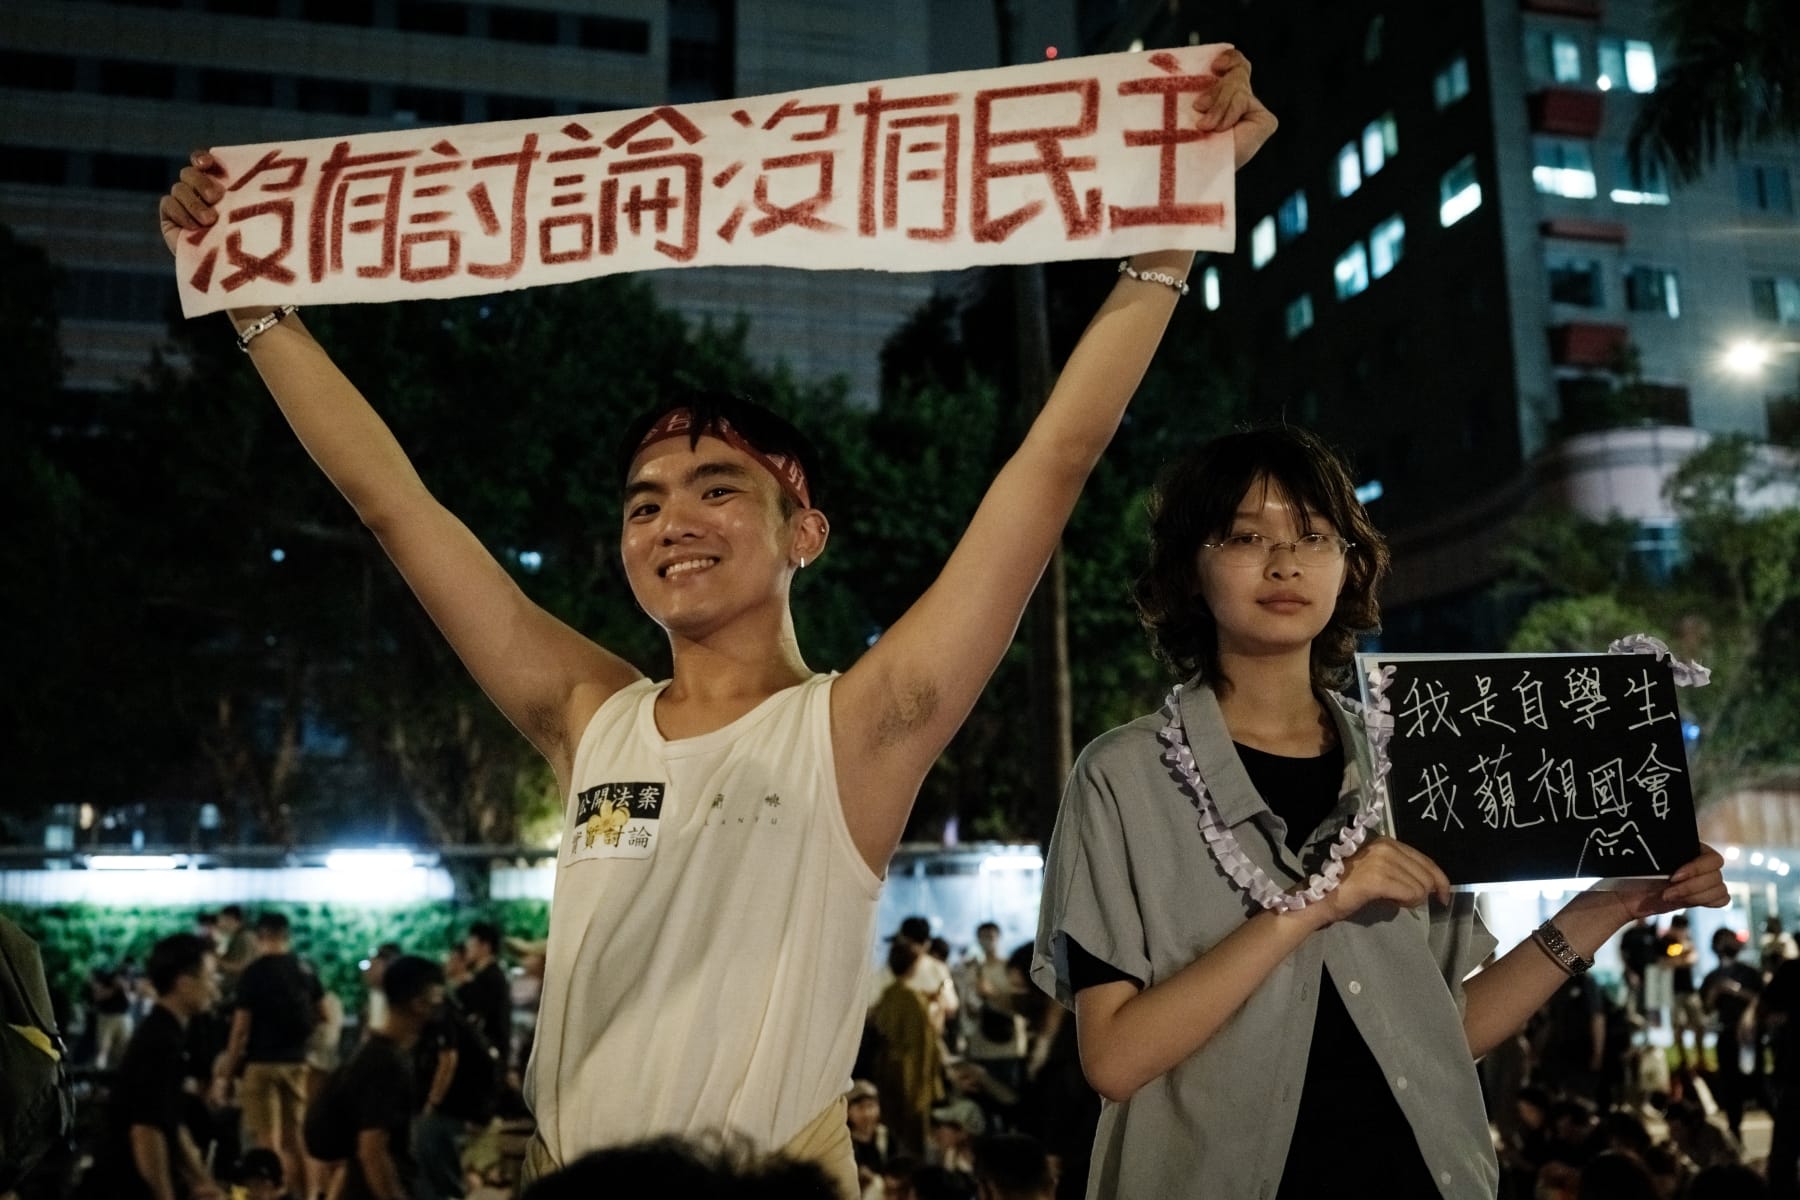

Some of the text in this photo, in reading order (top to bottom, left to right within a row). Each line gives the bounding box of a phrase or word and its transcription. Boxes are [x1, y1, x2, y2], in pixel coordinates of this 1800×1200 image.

[1400, 667, 1677, 738] 我是自學生
[1408, 743, 1682, 831] 我藐視國會
